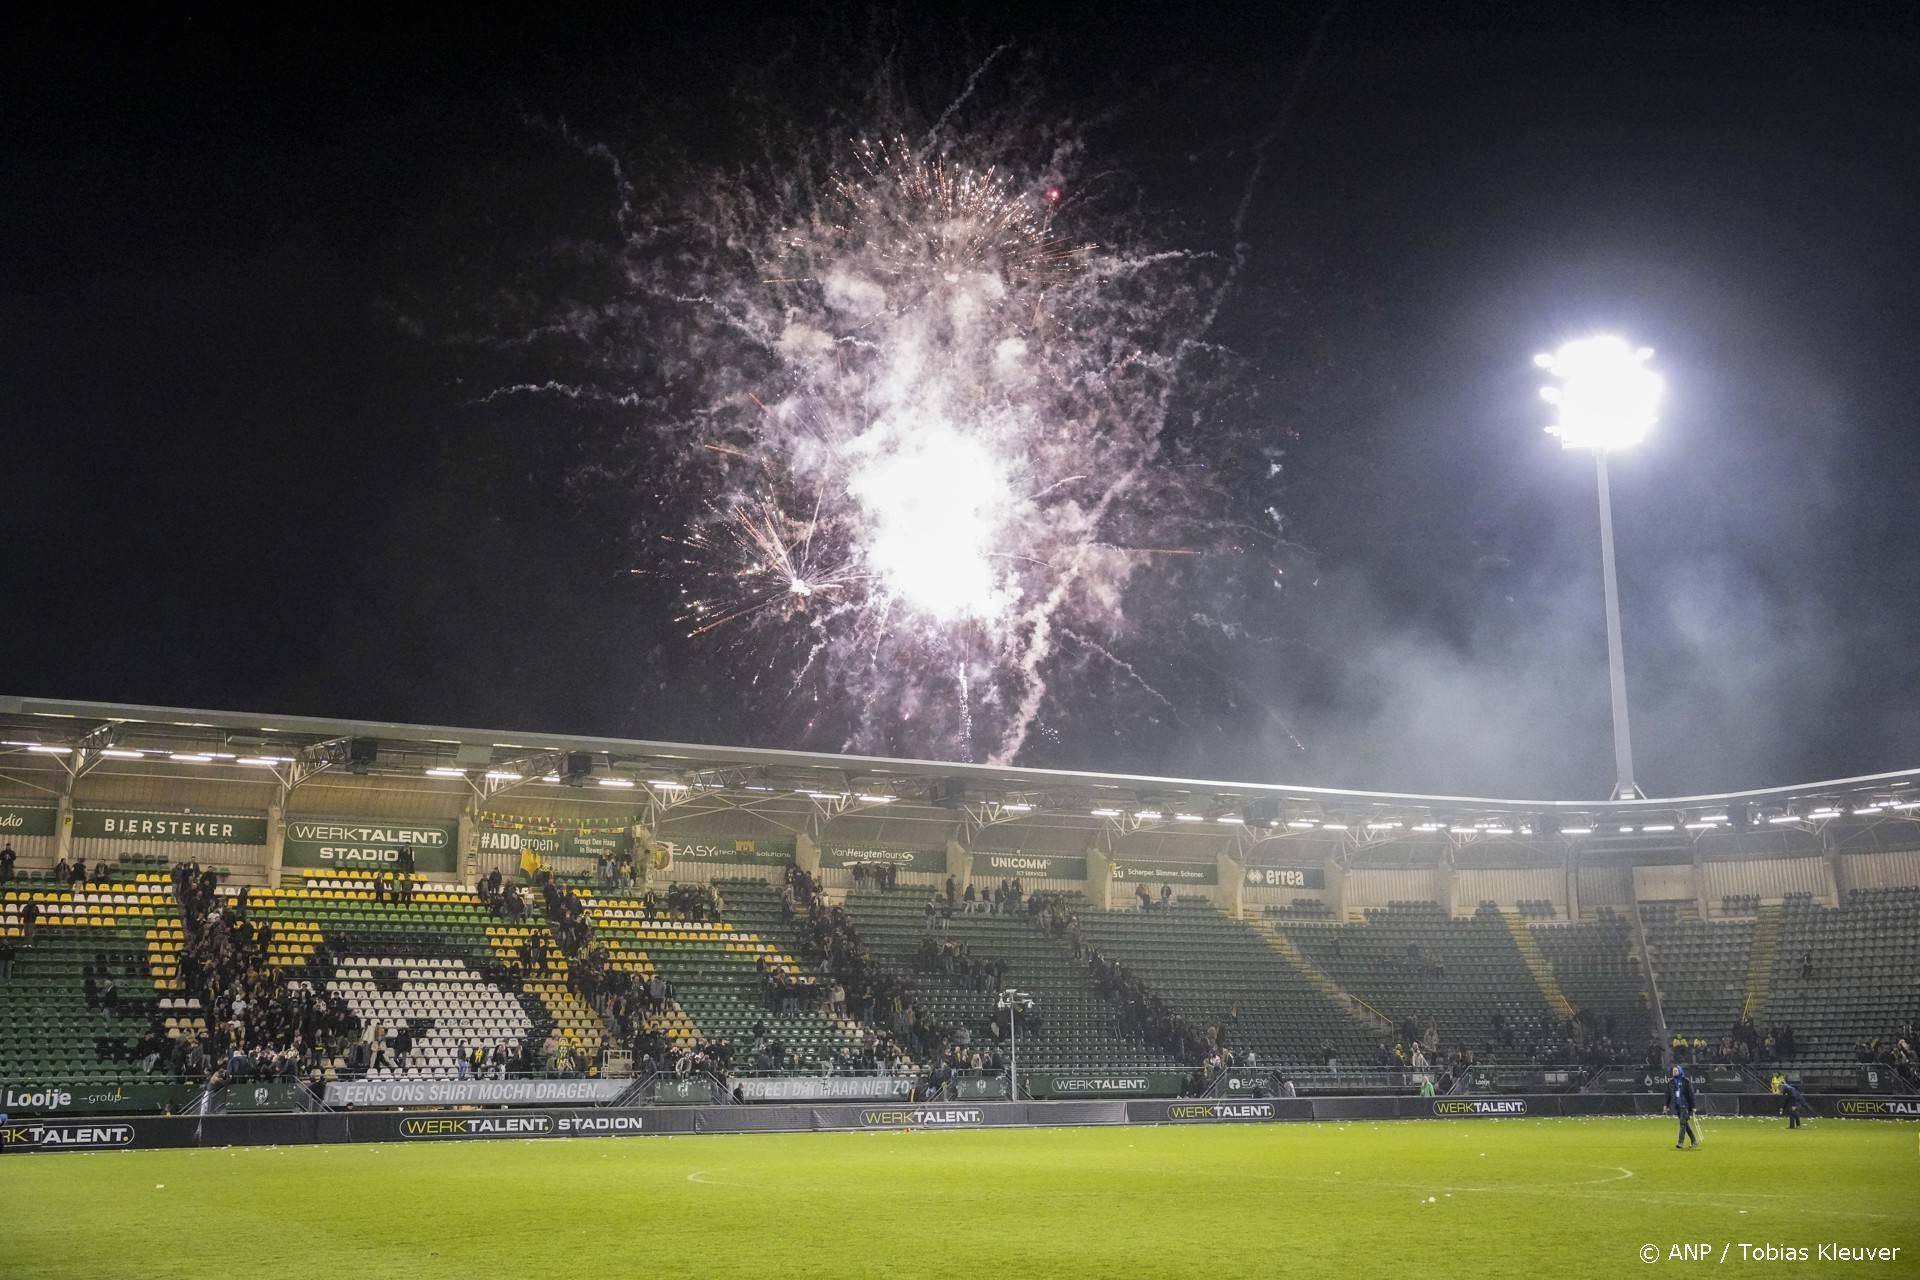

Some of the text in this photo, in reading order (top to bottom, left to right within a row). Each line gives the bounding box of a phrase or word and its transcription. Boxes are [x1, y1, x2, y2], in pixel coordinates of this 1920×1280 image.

[104, 818, 234, 838] BIERSTEKER
[295, 825, 443, 844] WERKTALENT.
[319, 847, 415, 862] STADIO
[671, 844, 717, 857] EASY
[991, 857, 1047, 870] UNICOMM
[1266, 869, 1304, 886] errea
[861, 1080, 891, 1095] NIET
[1056, 1079, 1146, 1090] WERKTALENT.
[6, 1089, 71, 1110] Looije
[344, 1085, 387, 1102] EENS
[391, 1085, 425, 1102] ONS
[428, 1084, 478, 1101] SHIRT
[478, 1083, 536, 1100] MOCHT
[1172, 1105, 1272, 1118] WERKTALENT.
[1437, 1102, 1525, 1113] WERKTALENT.
[406, 1117, 643, 1133] WERKTALENT. STADION
[865, 1111, 981, 1124] WERKTALENT.
